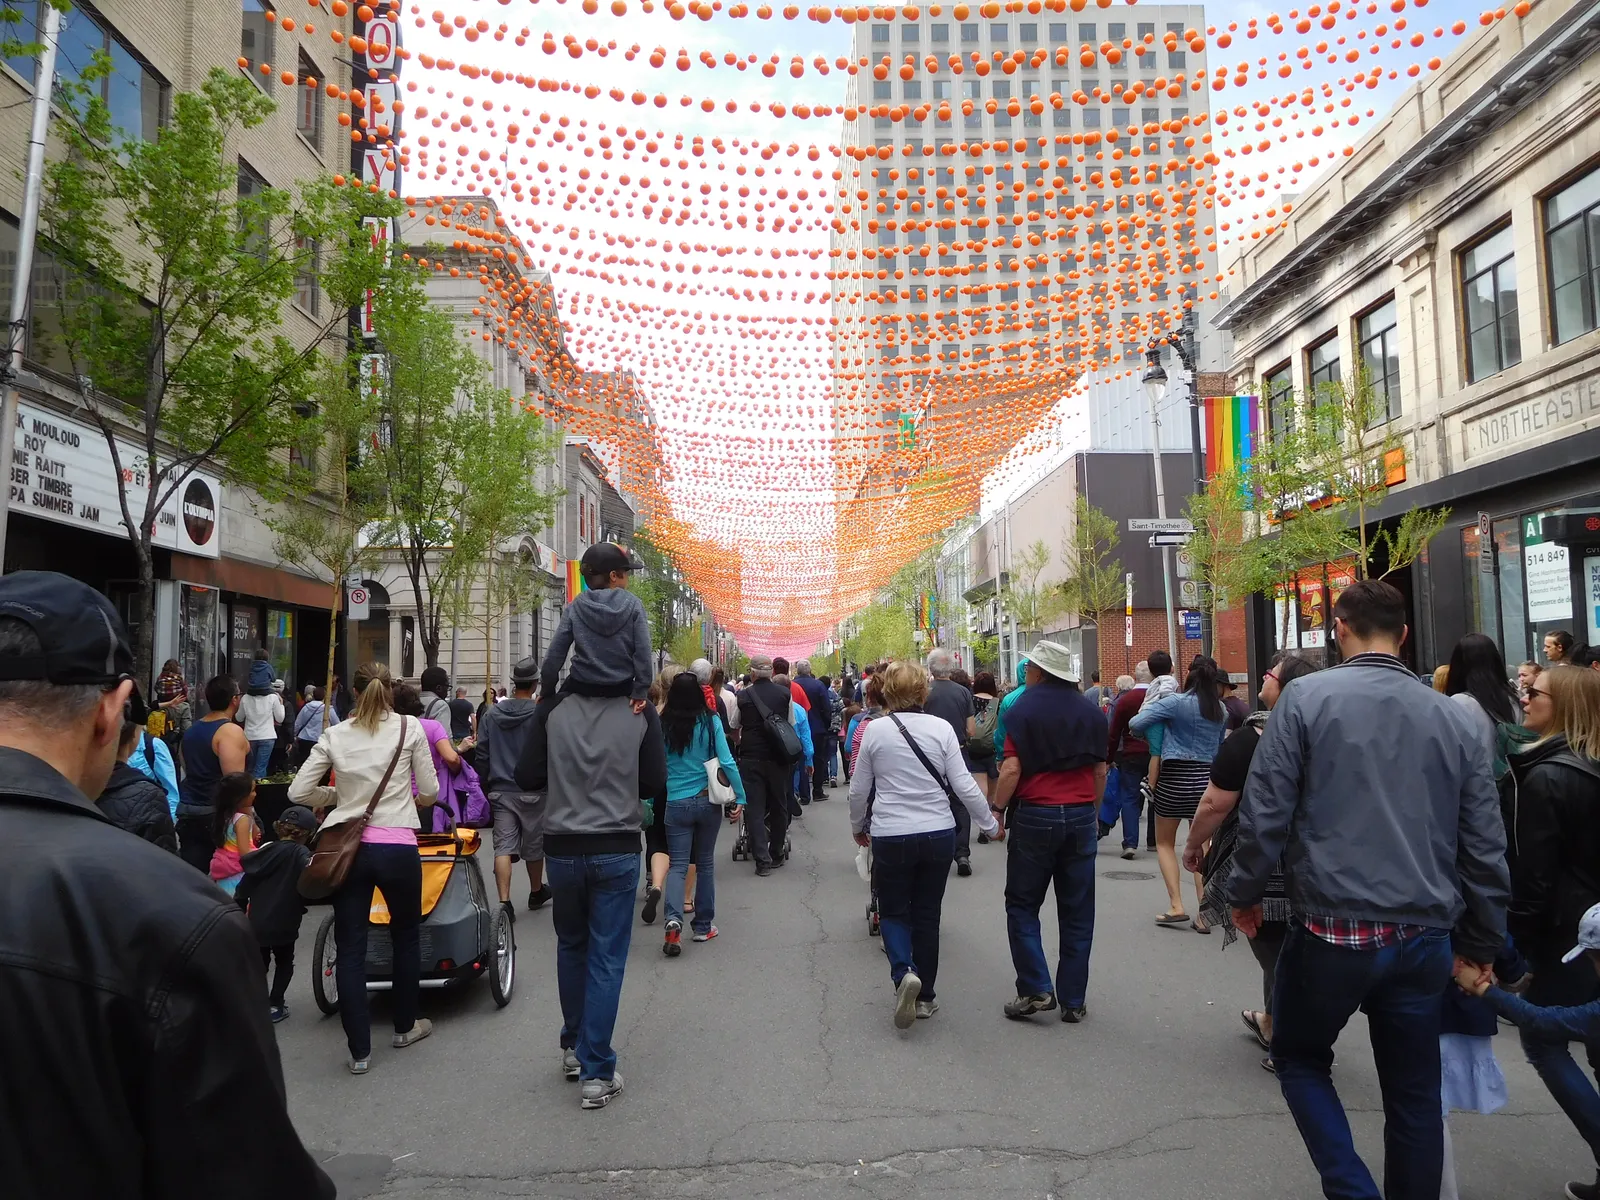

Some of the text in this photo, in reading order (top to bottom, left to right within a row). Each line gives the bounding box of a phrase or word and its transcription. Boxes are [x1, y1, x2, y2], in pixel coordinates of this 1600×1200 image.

[33, 419, 80, 448] MOULOUD
[24, 434, 46, 454] ROY
[35, 456, 65, 478] RAITT
[38, 475, 72, 498] TIMBRE
[135, 473, 145, 487] ET
[32, 492, 73, 515] SUMMER
[80, 504, 100, 522] JAM
[160, 512, 176, 527] JUIN
[1131, 522, 1181, 530] Saint-Timothée
[1527, 550, 1565, 566] 514 849
[234, 617, 248, 628] PHIL
[234, 628, 248, 640] ROY
